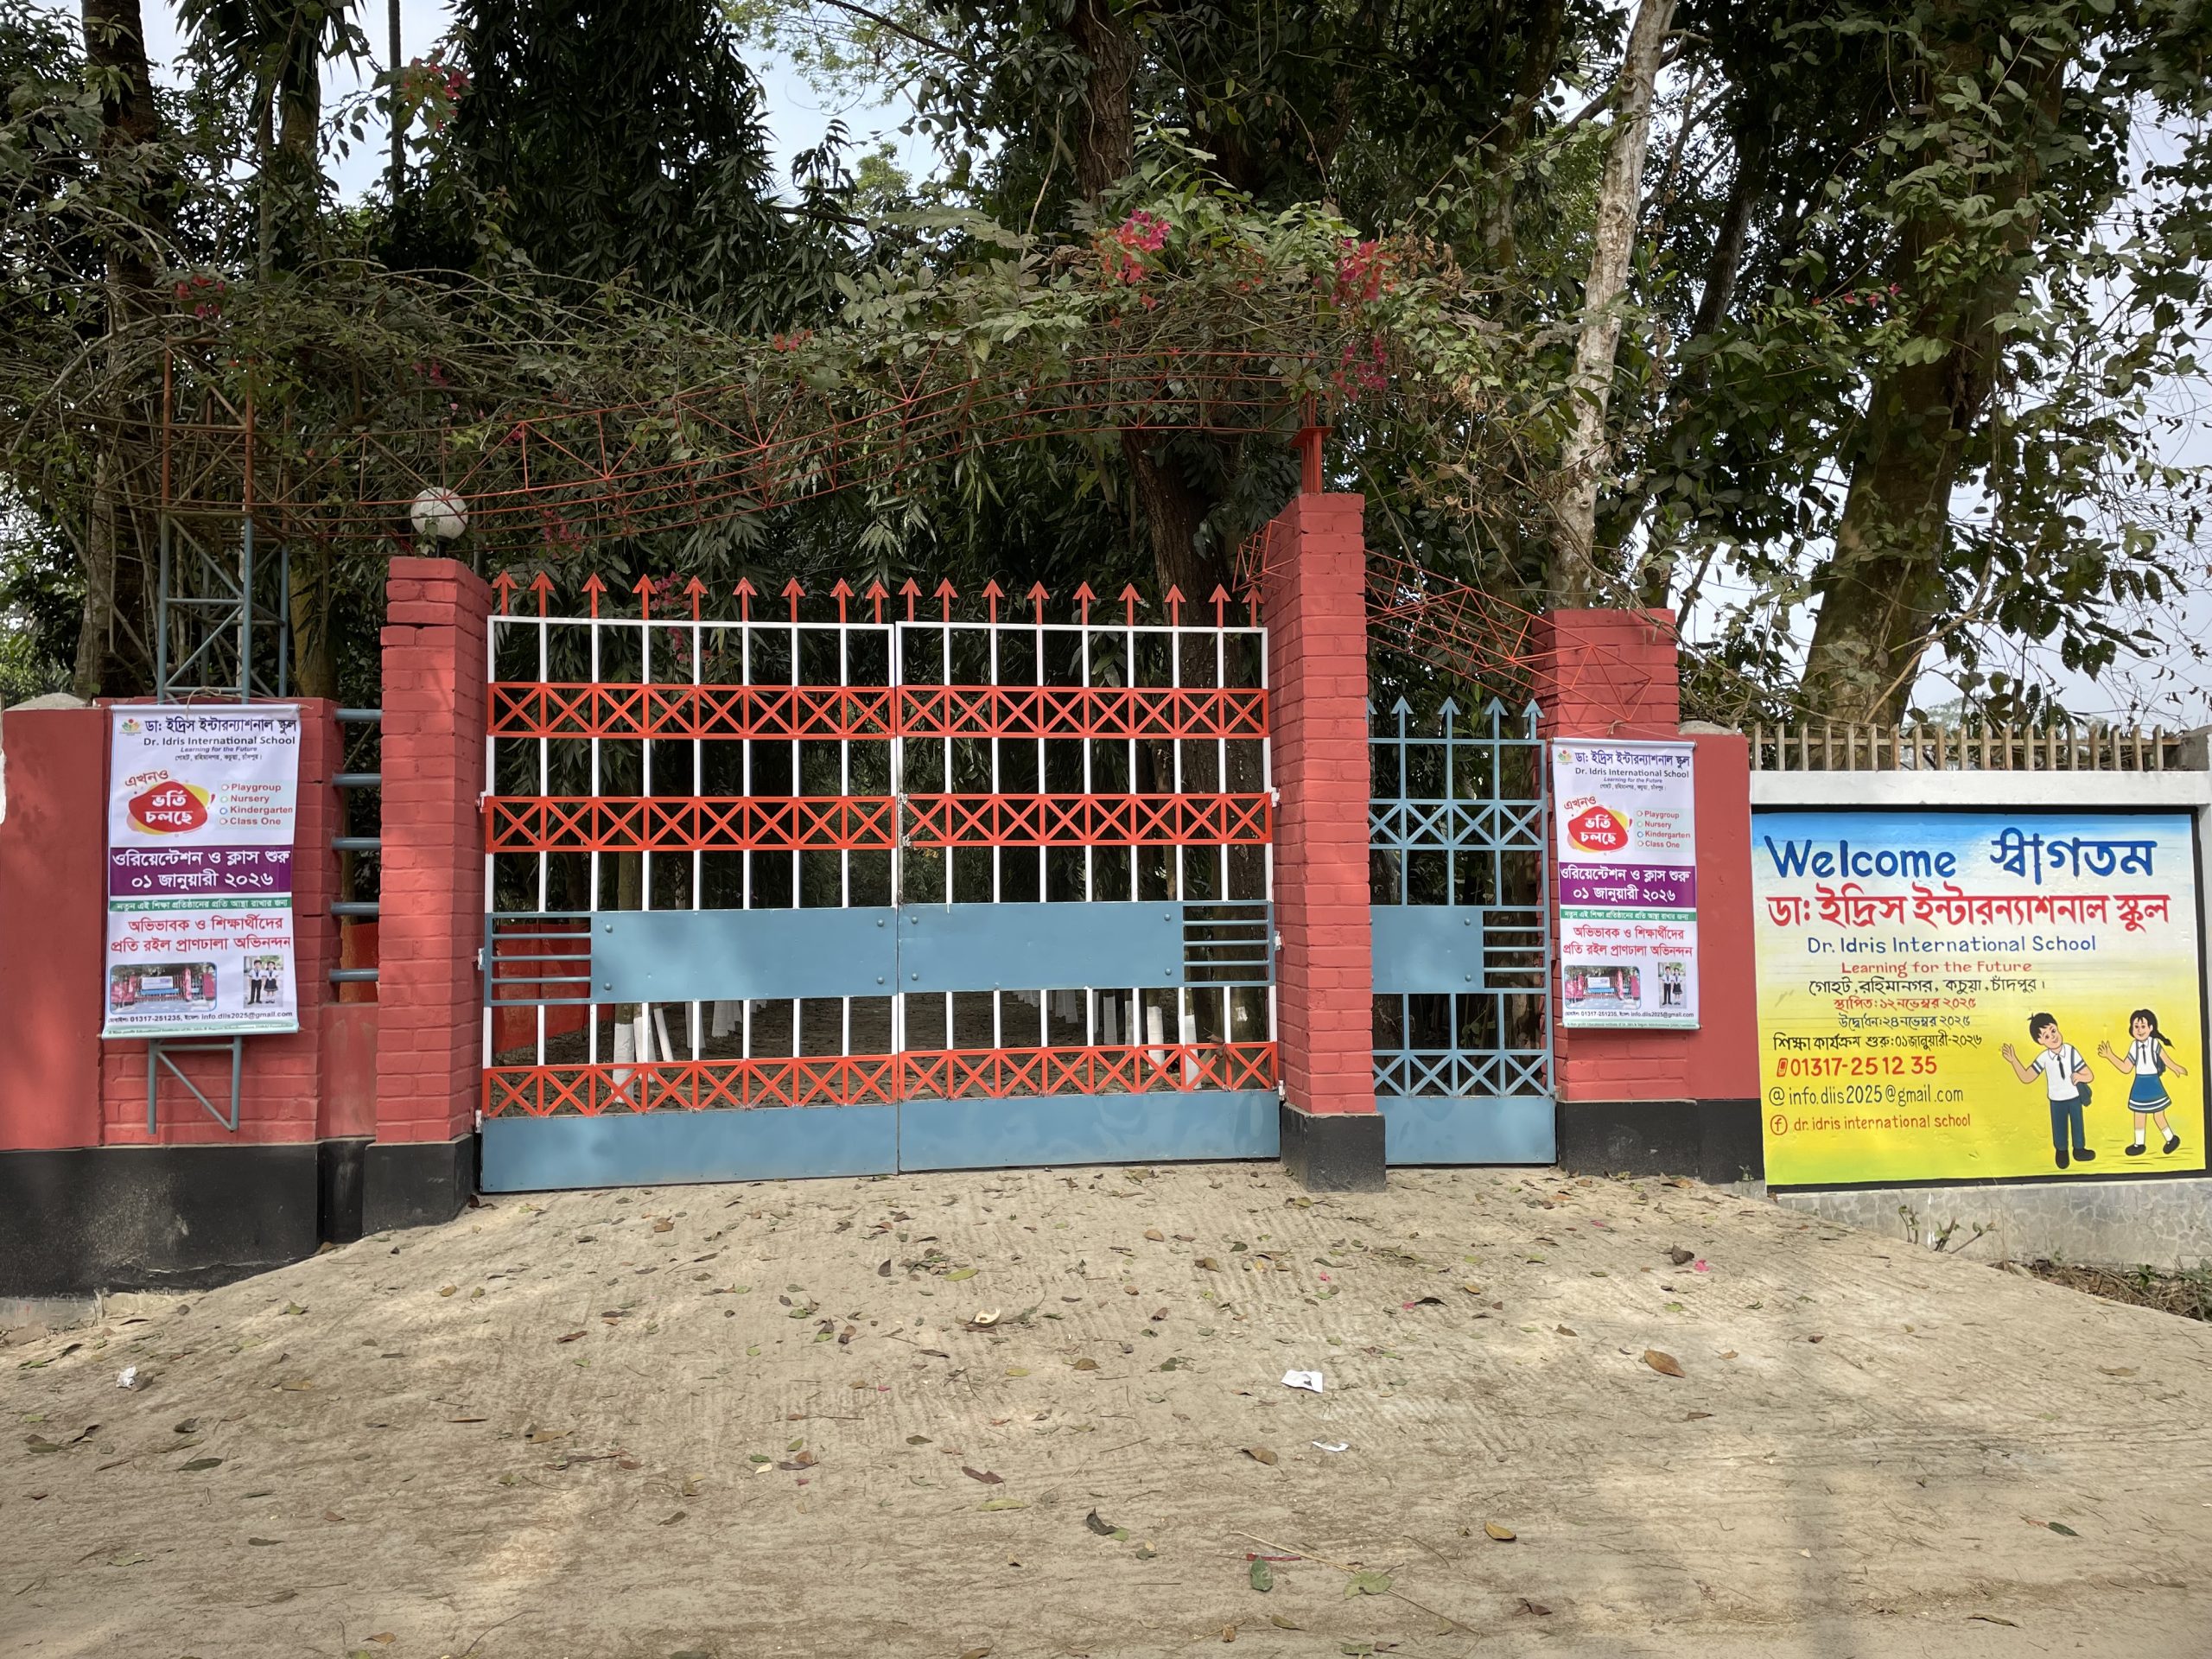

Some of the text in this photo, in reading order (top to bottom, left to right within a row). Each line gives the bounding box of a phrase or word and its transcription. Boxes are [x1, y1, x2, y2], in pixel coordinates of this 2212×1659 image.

[166, 715, 194, 734] ইদ্রিস
[199, 716, 274, 733] ইন্টারন্যাশনাল
[276, 719, 296, 735] স্কুল
[188, 736, 257, 746] International
[259, 736, 296, 745] School
[1591, 749, 1613, 766] ইদ্রিস
[1616, 750, 1673, 766] ইন্টারন্যাশনাল
[125, 769, 169, 788] এখনও
[1589, 767, 1607, 776] Idris
[1609, 768, 1662, 778] International
[1663, 770, 1689, 779] School
[231, 783, 282, 792] Playgroup
[151, 790, 187, 807] ভর্তি
[231, 795, 270, 804] Nursery
[1564, 795, 1597, 810] এখনও
[145, 810, 193, 824] চলছে
[231, 806, 293, 816] Kindergarten
[1644, 810, 1680, 820] Playgroup
[1585, 814, 1611, 830] ভর্তি
[1645, 821, 1672, 830] Nursery
[1580, 831, 1617, 845] চলছে
[1645, 830, 1691, 841] Kindergarten
[112, 849, 291, 867] ওরিয়েন্টেশন ও ক্লাস শুরু
[1764, 835, 1956, 878] Welcome
[131, 869, 274, 890] ০১ জানুয়ারী ২০২৬
[1560, 864, 1691, 883] ওরিয়েন্টেশন ও ক্লাস শুরু
[1573, 884, 1676, 903] ০১ জানুয়ারী ২০২৬
[1815, 882, 1908, 930] ইদ্রিস
[1912, 880, 2111, 930] ইন্টারন্যাশনাল
[2113, 894, 2171, 933] স্কুল
[128, 913, 283, 932] অভিভাবক ও শিক্ষার্থীদের
[1573, 924, 1685, 940] অভিভাবক ও শিক্ষার্থীদের
[111, 933, 291, 953] প্রতি রইল প্রাণঢালা অভিনন্দন
[1563, 941, 1694, 957] প্রতি রইল প্রাণঢালা অভিনন্দন
[1808, 935, 2096, 953] Dr. Idris International School
[1841, 961, 2032, 978] Learning for the Future
[1942, 997, 1977, 1010] ২০২৫
[1939, 1016, 1970, 1029] ২০২৫
[1773, 1033, 1811, 1052] শিক্ষা
[1814, 1033, 1860, 1052] কার্যক্রম
[1794, 1117, 1810, 1132] dr.
[1812, 1116, 1841, 1131] idris
[1844, 1115, 1930, 1130] international
[1934, 1113, 1971, 1128] school
